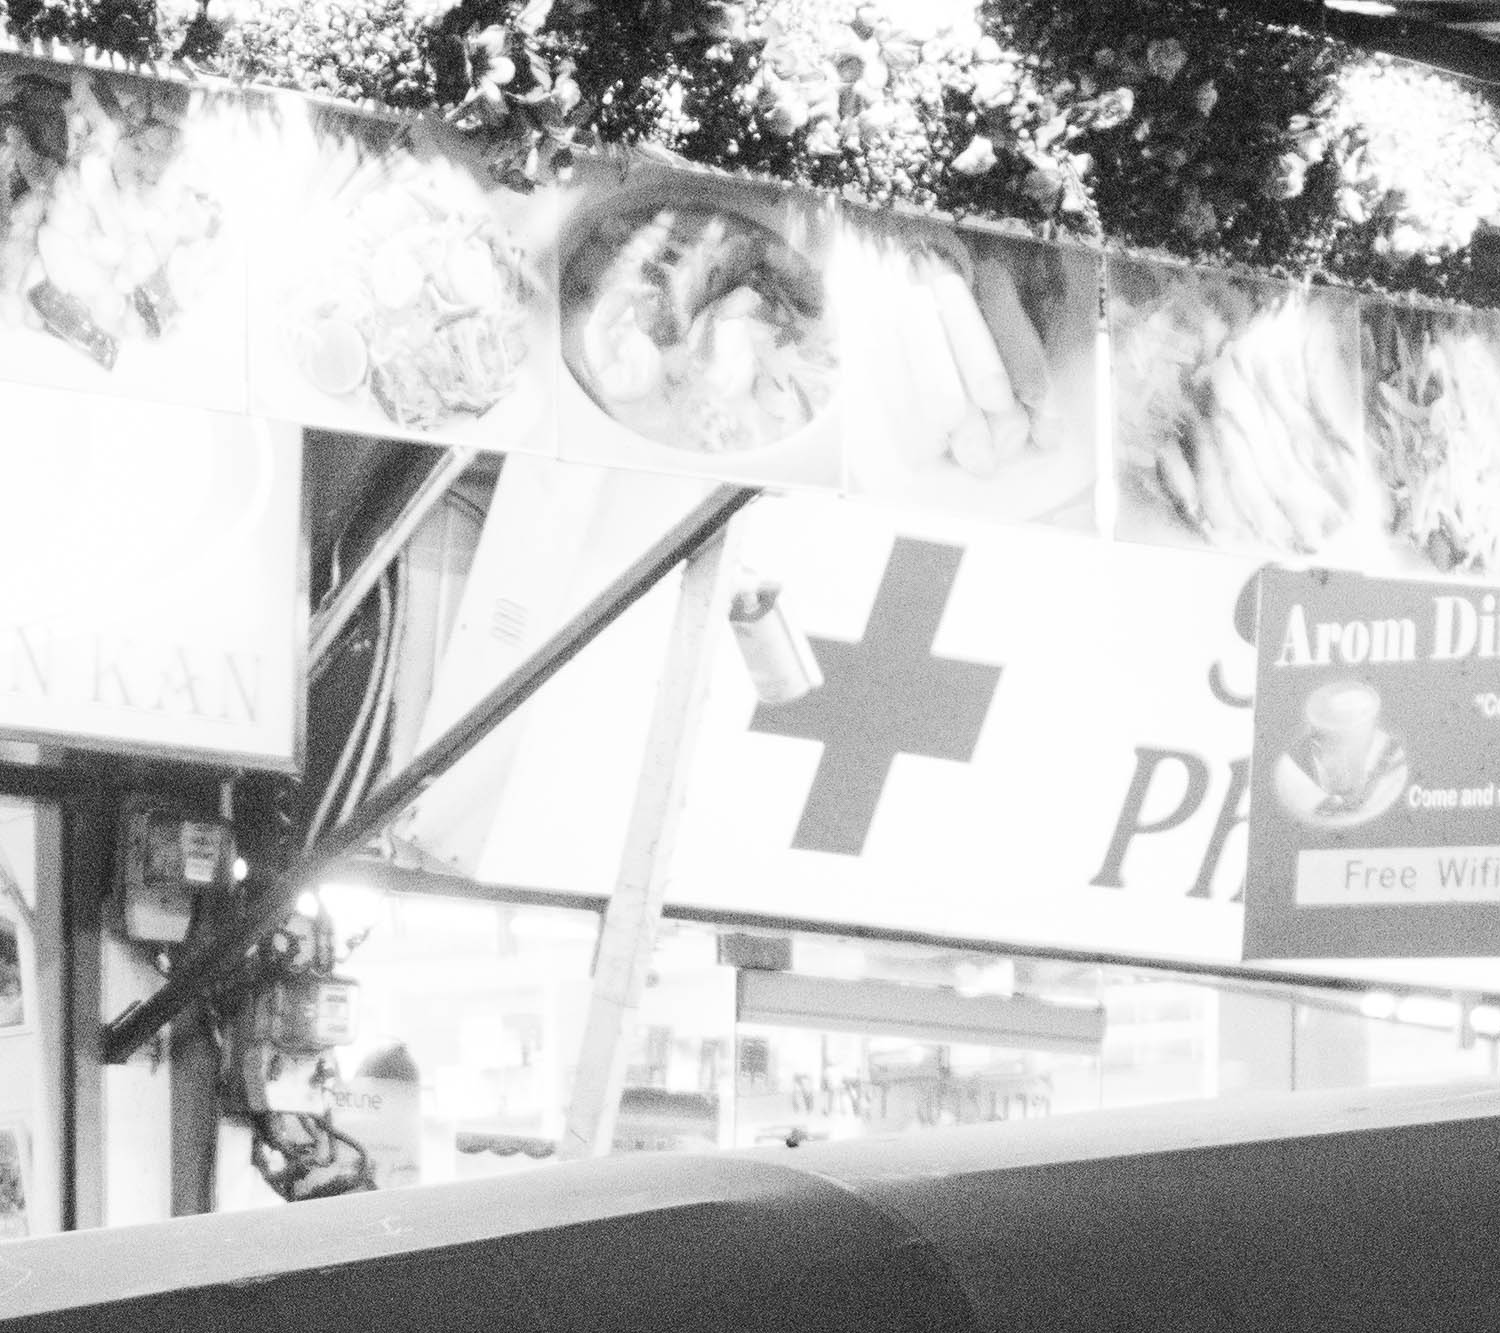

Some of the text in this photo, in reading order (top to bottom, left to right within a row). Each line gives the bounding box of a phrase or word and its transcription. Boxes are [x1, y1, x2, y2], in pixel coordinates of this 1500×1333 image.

[1275, 602, 1415, 668] Arom
[1408, 784, 1458, 809] Come
[1459, 783, 1494, 808] and
[1344, 857, 1417, 890] Free
